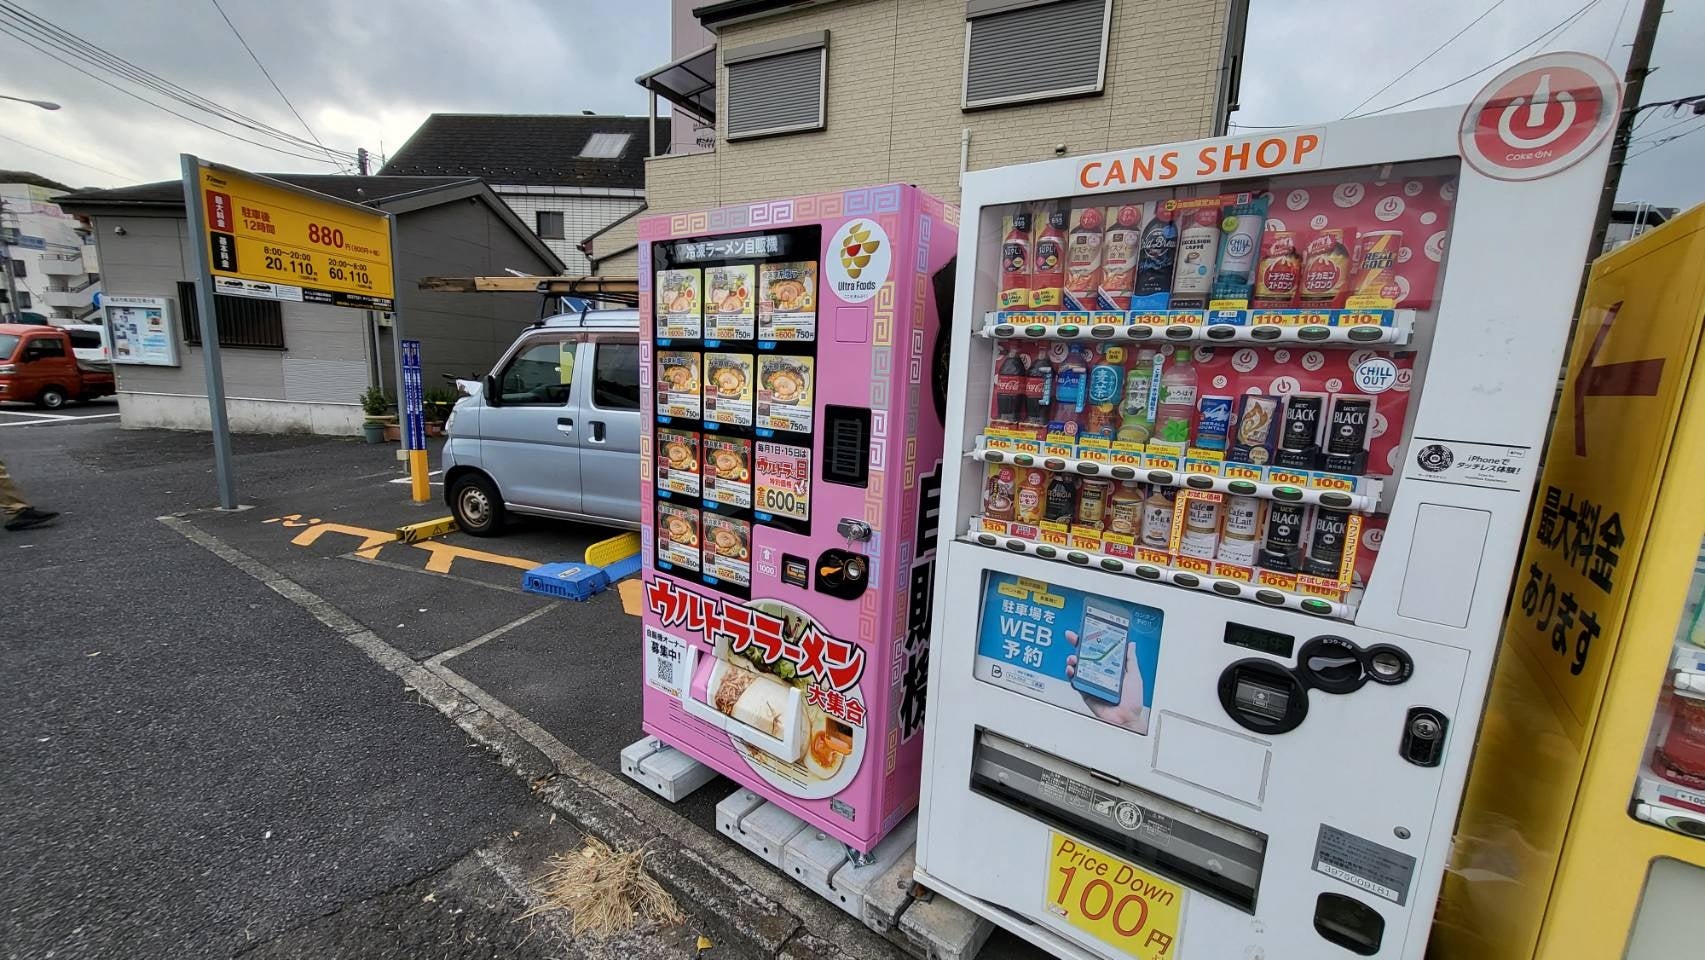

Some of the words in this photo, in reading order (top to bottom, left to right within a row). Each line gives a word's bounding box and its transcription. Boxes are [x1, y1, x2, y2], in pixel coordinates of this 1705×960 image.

[1080, 152, 1178, 189] CANS
[1196, 134, 1319, 176] SHOP
[242, 207, 270, 222] 駐車後
[244, 220, 276, 235] 12時間
[308, 223, 344, 249] 880
[685, 236, 779, 259] 冷凍ラーメン自販機
[838, 282, 854, 292] Ultra
[1136, 315, 1166, 324] 130円
[1172, 315, 1200, 324] 140円
[1256, 315, 1288, 325] 110円
[1292, 315, 1326, 325] 110円
[1342, 315, 1378, 325] 110円
[1360, 366, 1392, 377] CHILL
[1362, 376, 1387, 386] OUT
[1287, 408, 1317, 421] BLACK
[1334, 412, 1366, 424] BLACK
[758, 444, 806, 458] 毎月1日・15日は
[1112, 455, 1138, 465] 140円
[1148, 458, 1174, 469] 110円
[1467, 455, 1511, 466] iPhoneで
[1190, 463, 1216, 474] 110円
[1229, 468, 1258, 479] 110円
[1456, 462, 1521, 475] タッチレス体験!
[1272, 474, 1305, 485] 100円
[1314, 478, 1350, 490] 100円
[767, 489, 806, 514] 600円
[1187, 490, 1221, 502] お試し価格
[1197, 510, 1212, 520] Lait
[1235, 516, 1252, 526] Lait
[1272, 512, 1300, 525] BLACK
[1316, 520, 1346, 534] BLACK
[1074, 538, 1097, 550] 110円
[1534, 485, 1626, 595] 最大料金
[1139, 552, 1166, 564] 110円
[1177, 558, 1206, 570] 100円
[760, 564, 774, 574] 1000
[1216, 566, 1246, 580] 100円
[1262, 576, 1293, 589] 100円
[1298, 576, 1339, 588] お試し価格
[1002, 599, 1056, 624] 駐車場を
[1520, 557, 1602, 677] あります
[646, 577, 867, 691] ウルトララーメン
[1000, 616, 1053, 647] WEB
[651, 640, 681, 664] 募集中!
[1002, 638, 1043, 668] 予約
[807, 682, 867, 727] 大集合
[1056, 839, 1109, 876] Price
[1114, 865, 1175, 906] Down
[1324, 865, 1391, 898] 3975009181
[1056, 866, 1173, 956] 100円
